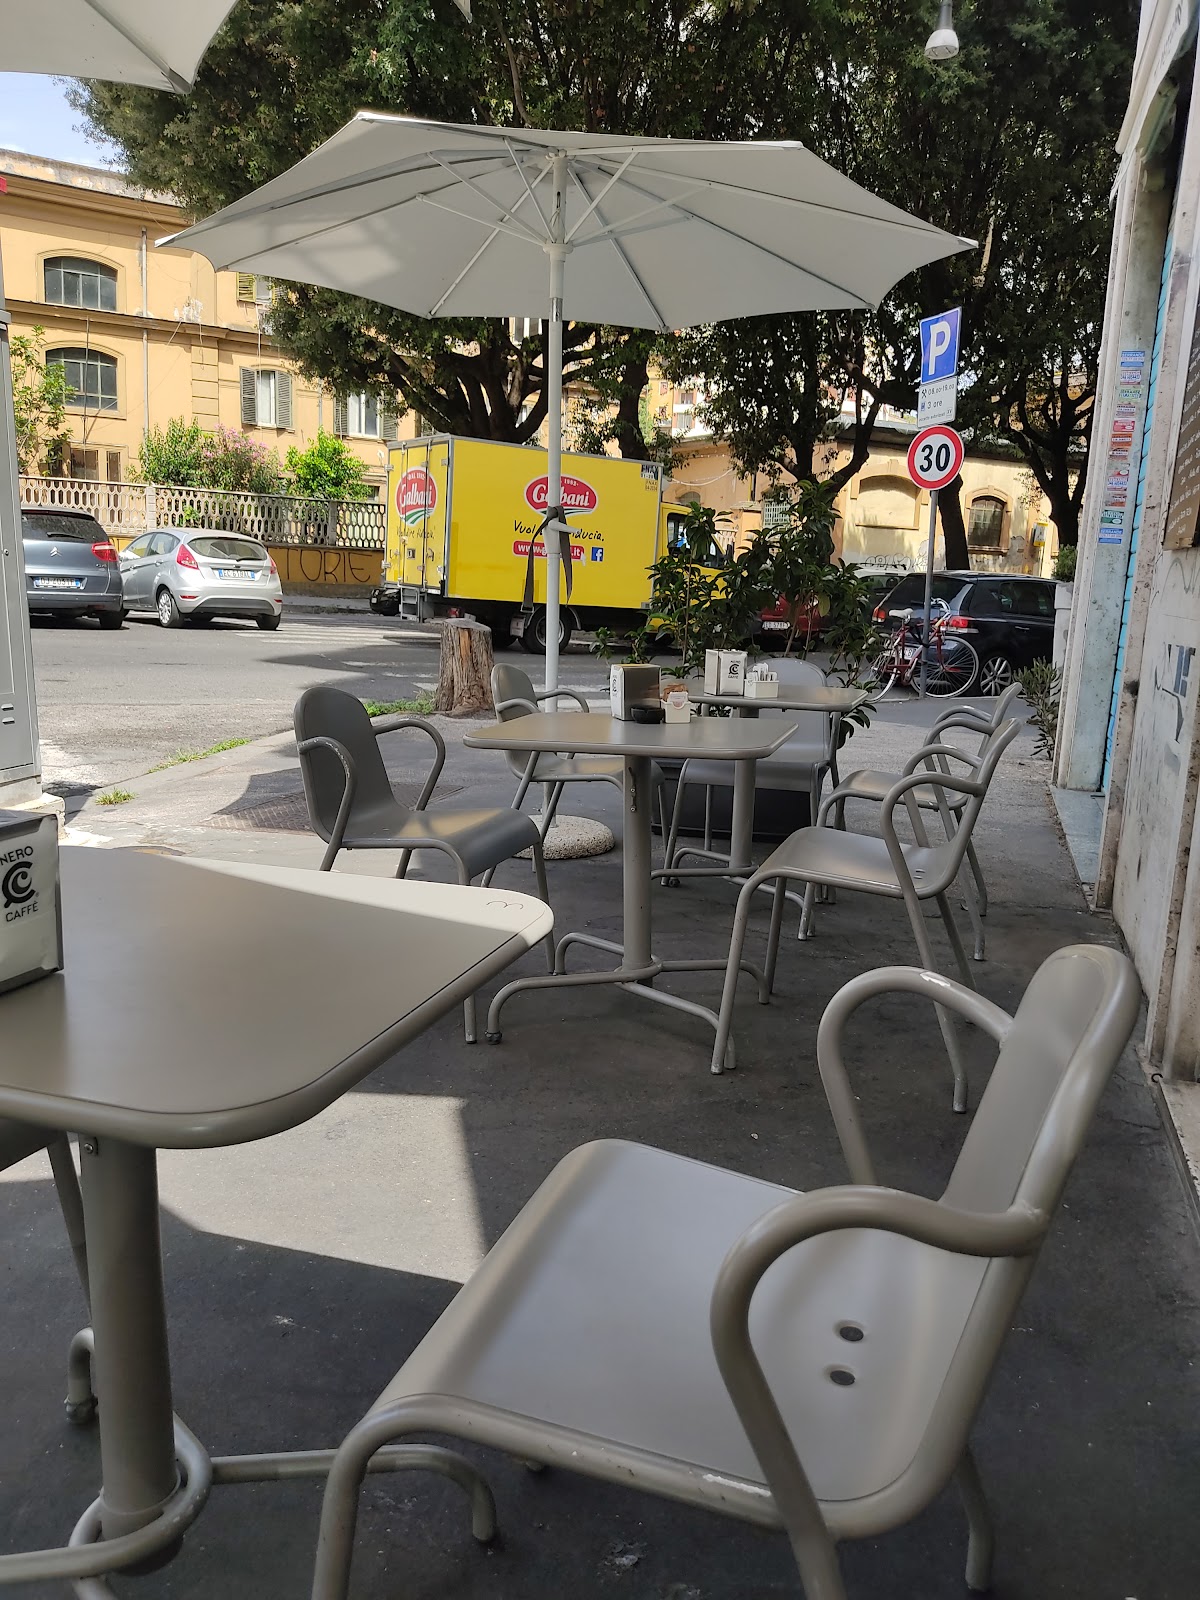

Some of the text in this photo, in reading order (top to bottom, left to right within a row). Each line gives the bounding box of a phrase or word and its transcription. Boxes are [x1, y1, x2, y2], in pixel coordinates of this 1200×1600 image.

[928, 320, 951, 376] P
[919, 443, 951, 473] 30
[532, 484, 590, 506] Gbani
[0, 845, 34, 866] NERO
[5, 900, 39, 923] CAFFÈ
